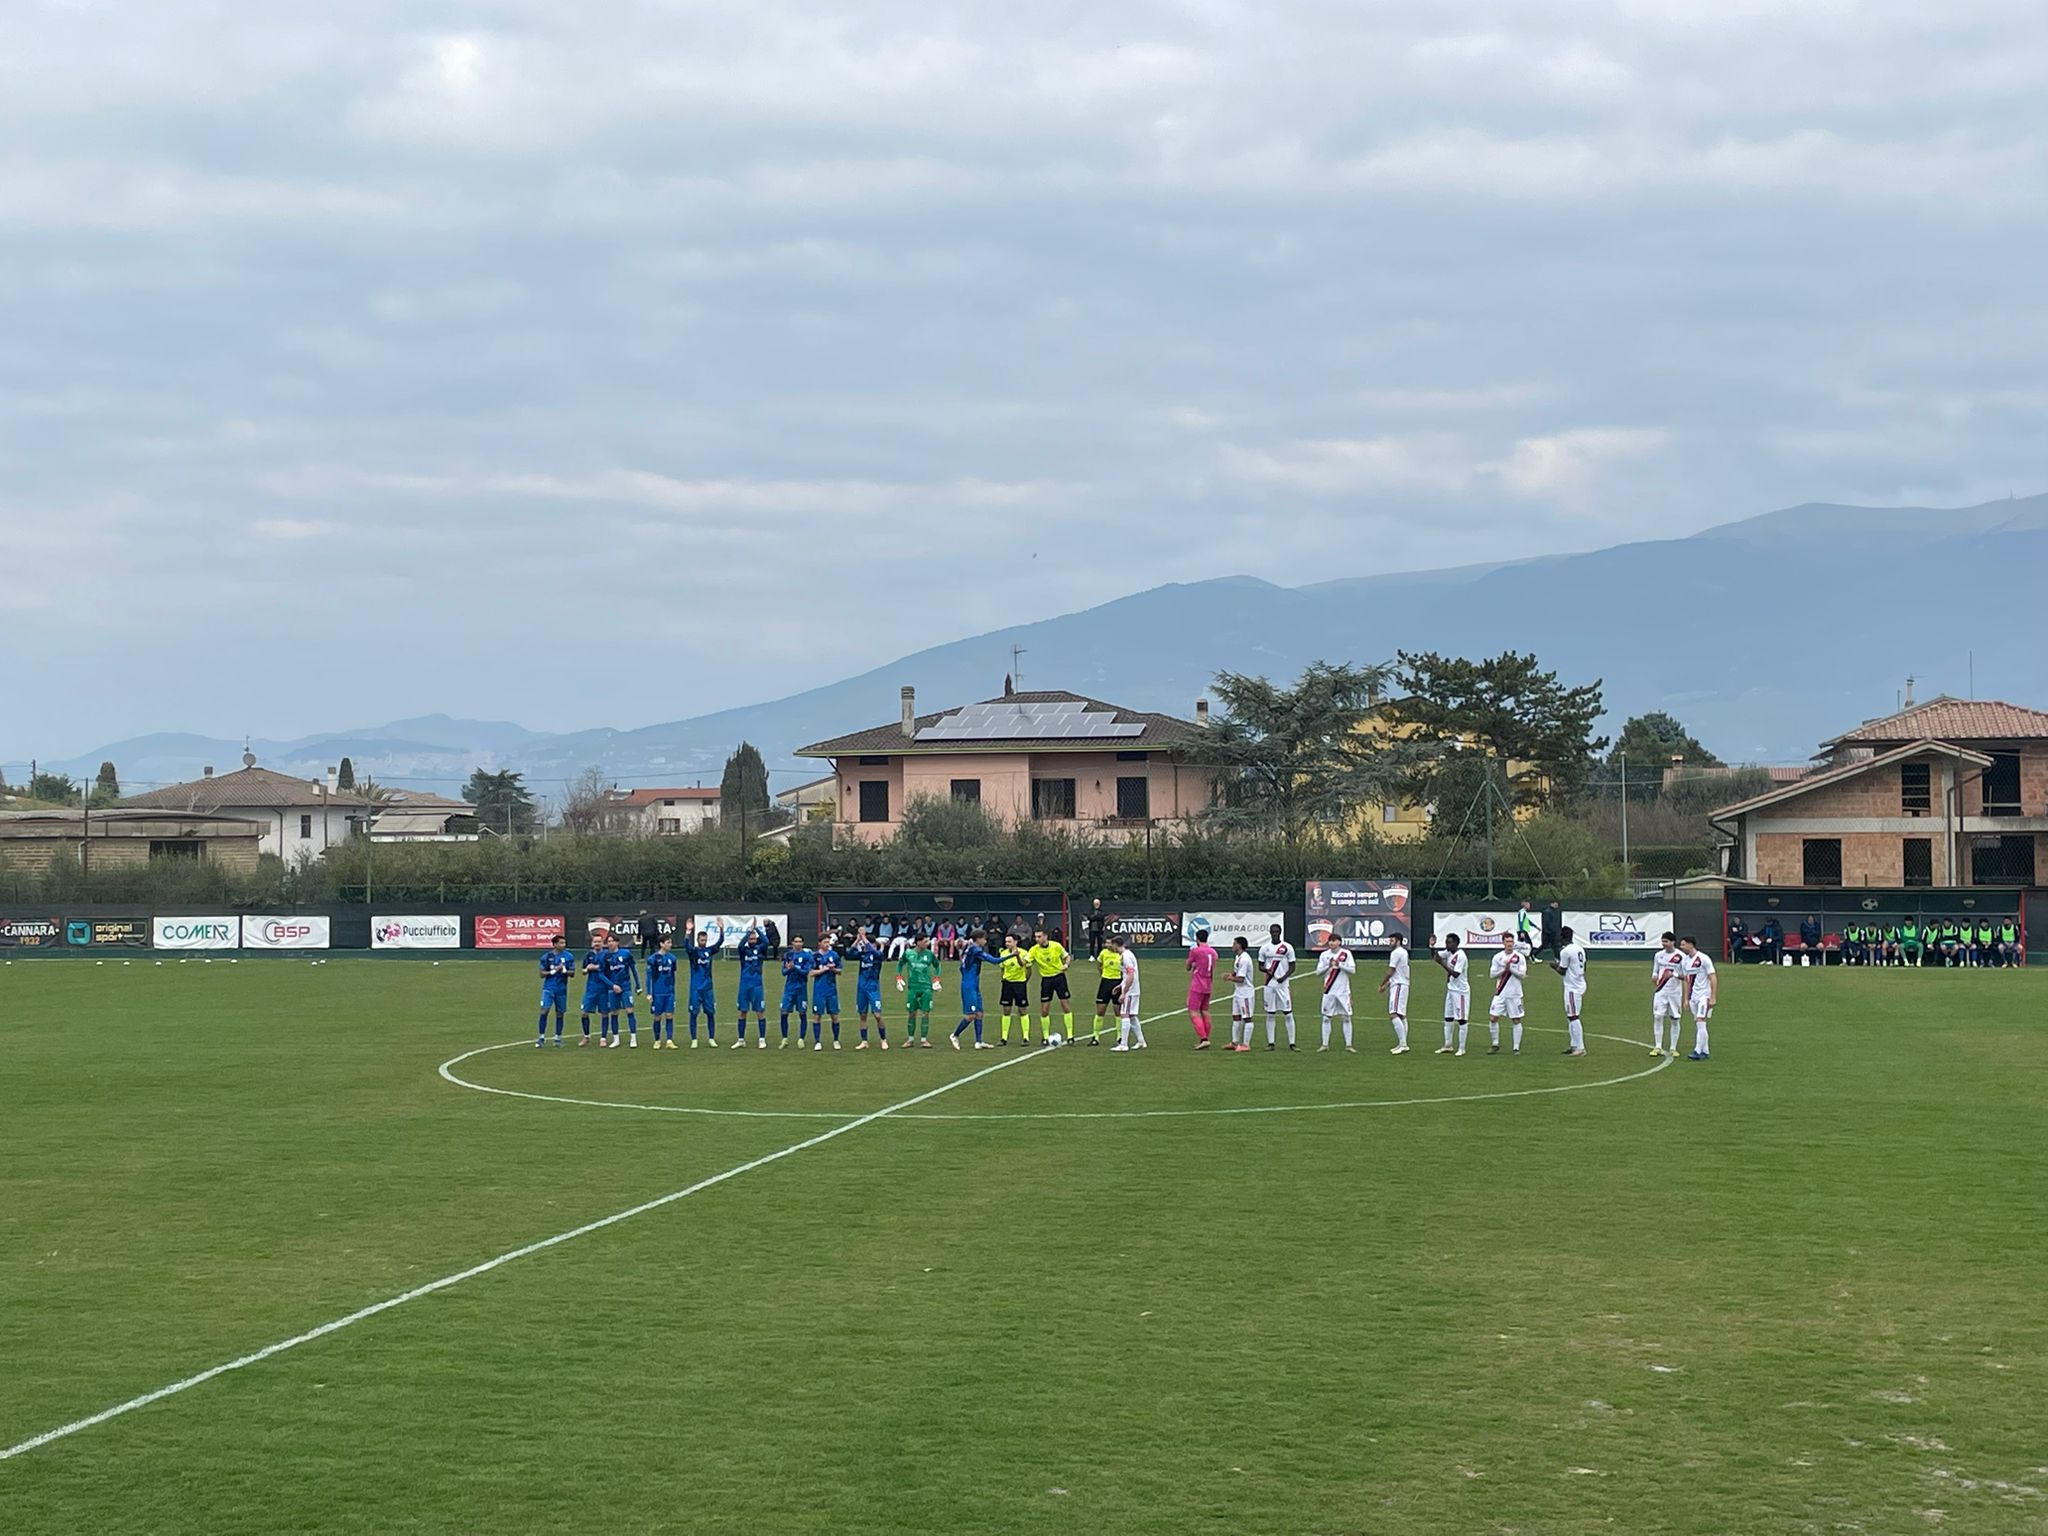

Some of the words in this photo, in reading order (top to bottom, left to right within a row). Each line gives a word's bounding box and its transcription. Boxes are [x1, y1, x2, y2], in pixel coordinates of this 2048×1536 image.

[95, 923, 133, 934] original
[505, 918, 535, 928] STAR
[537, 918, 561, 928] CAR
[615, 923, 672, 934] CANRA
[1111, 921, 1173, 933] CANNARA
[1355, 920, 1384, 937] NO
[1599, 914, 1638, 931] ERA
[4, 925, 56, 936] CANNARA
[402, 925, 457, 937] Pucciufficio
[1577, 951, 1584, 968] 9
